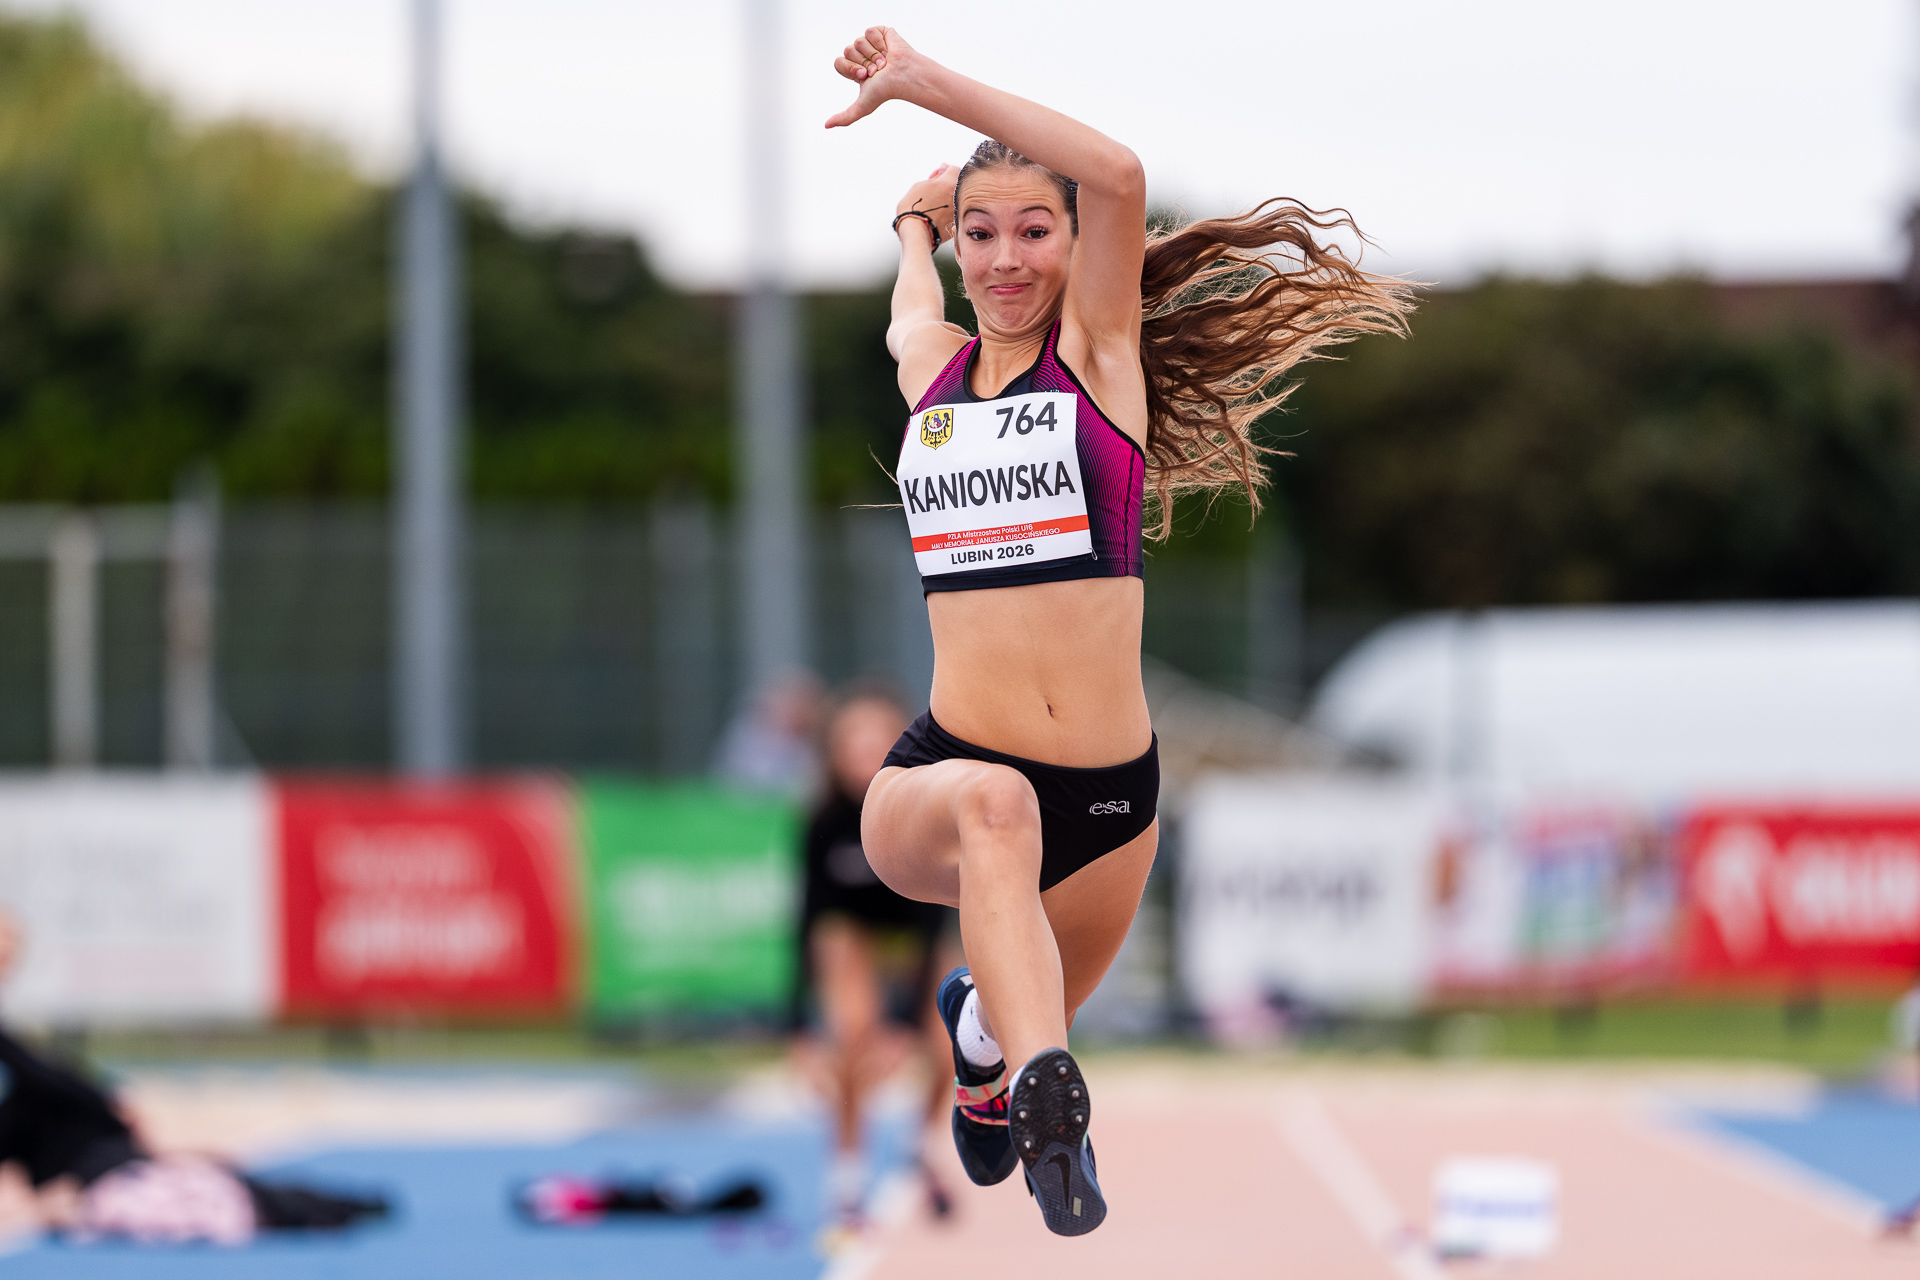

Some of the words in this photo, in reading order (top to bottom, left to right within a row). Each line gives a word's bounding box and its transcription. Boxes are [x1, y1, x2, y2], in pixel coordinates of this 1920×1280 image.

[996, 402, 1057, 439] 764
[904, 461, 1076, 514] KANIOWSKA
[947, 532, 962, 541] PZLA
[962, 528, 1001, 539] Mistrzostwa
[1001, 525, 1020, 533] Polski
[975, 536, 1005, 545] JANUSZA
[1005, 528, 1060, 541] KUSOCIŃSKIEGO
[951, 549, 994, 565] LUBIN
[997, 543, 1035, 560] 2026
